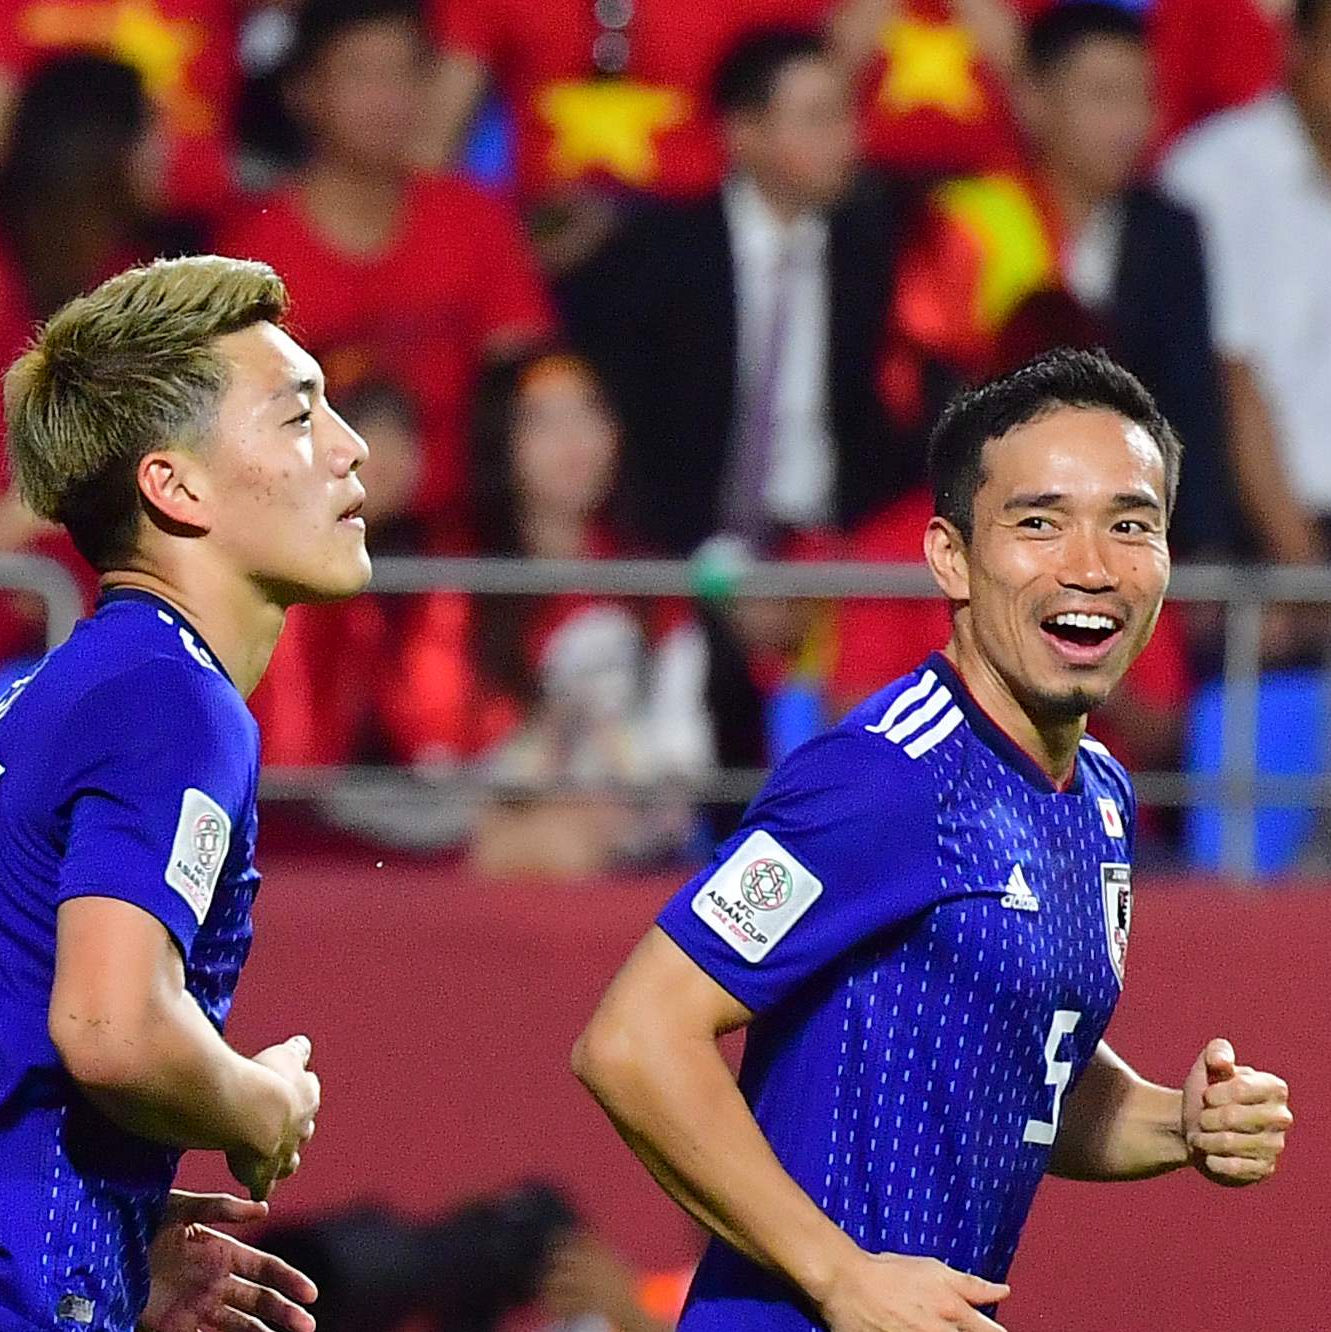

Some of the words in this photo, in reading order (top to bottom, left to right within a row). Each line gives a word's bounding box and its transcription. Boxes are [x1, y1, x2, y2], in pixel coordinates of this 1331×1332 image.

[707, 890, 743, 923] ASIAN
[742, 921, 768, 945] CUP
[733, 900, 755, 920] AFC
[1023, 1010, 1081, 1145] 5
